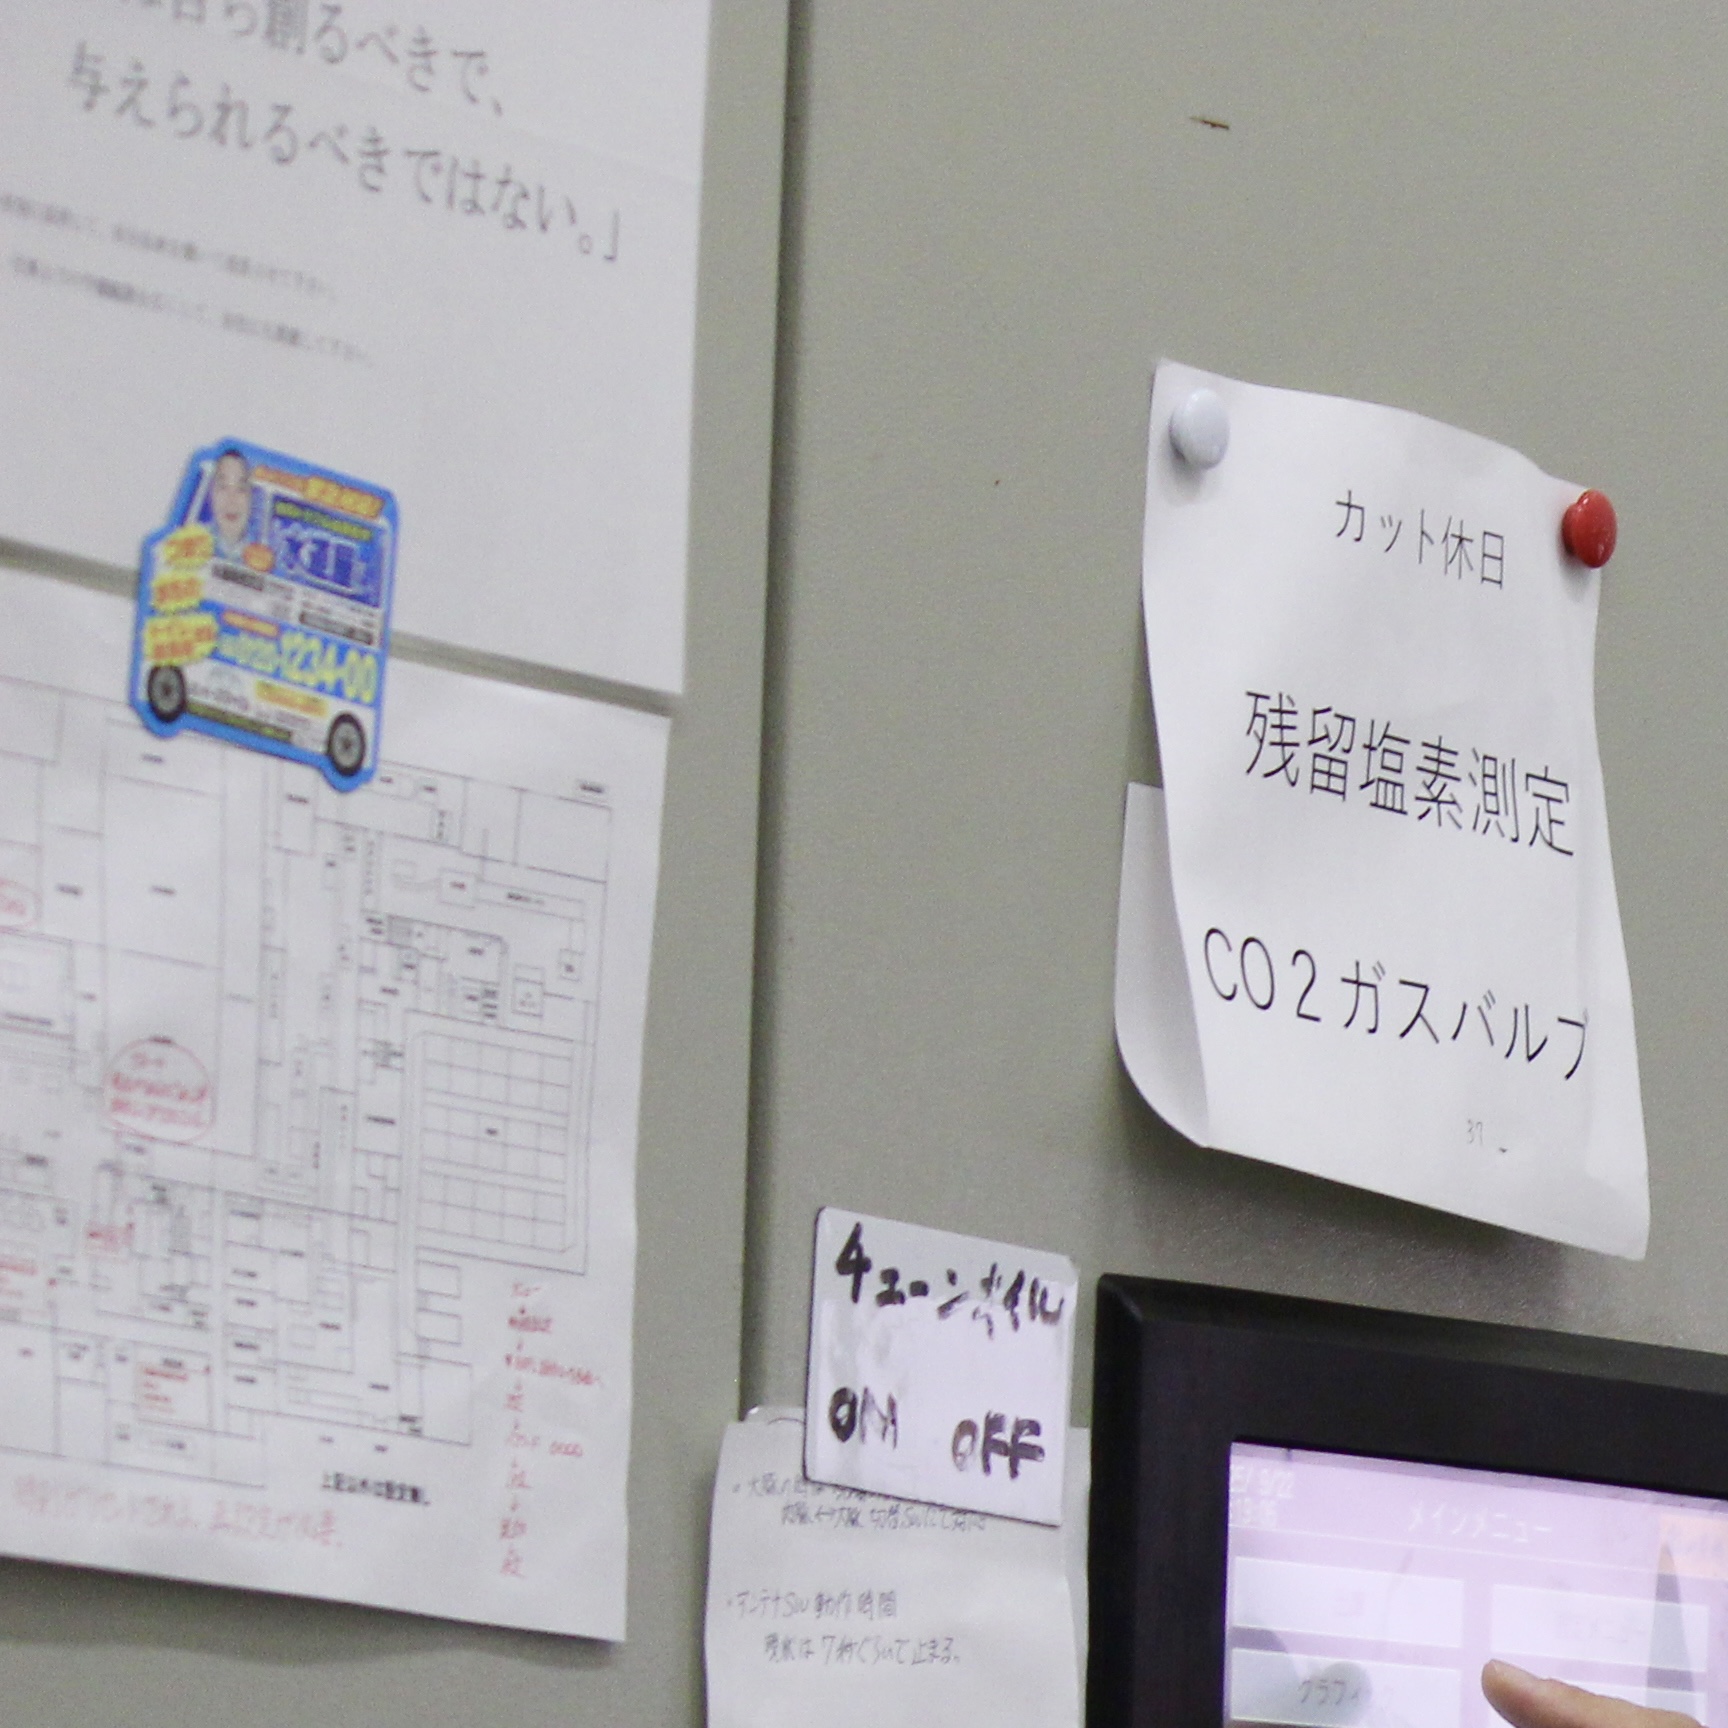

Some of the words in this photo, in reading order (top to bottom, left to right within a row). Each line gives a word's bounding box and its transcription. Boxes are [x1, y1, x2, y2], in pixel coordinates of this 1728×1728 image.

[1334, 488, 1506, 590] カット休日
[1244, 690, 1575, 857] 残留塩素測定
[950, 1410, 1047, 1481] OFF
